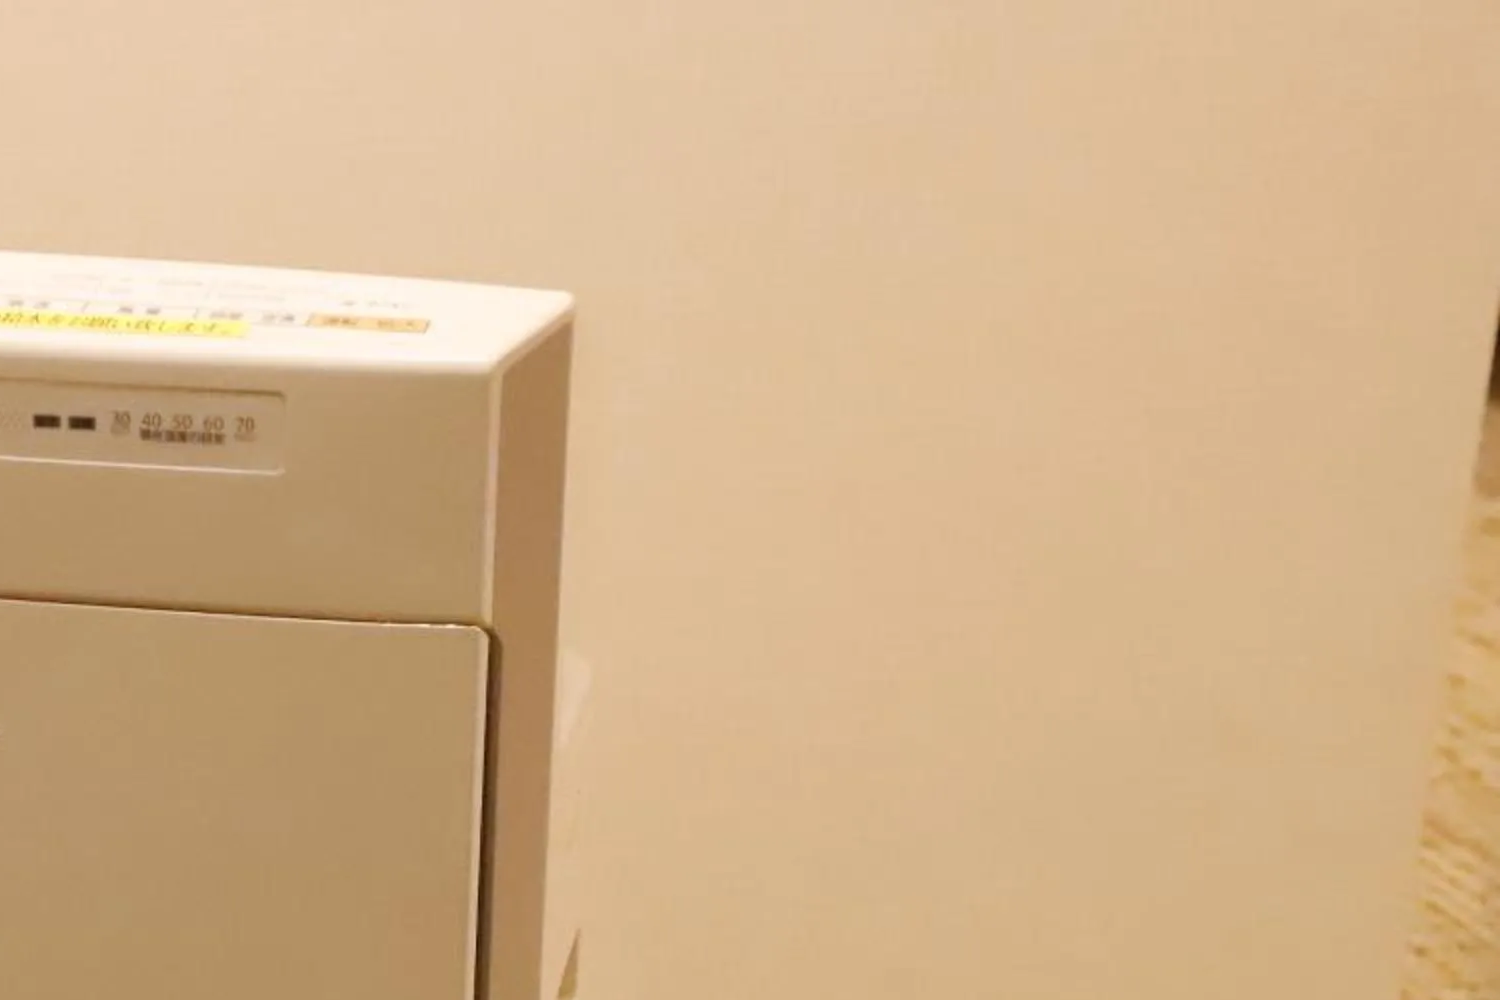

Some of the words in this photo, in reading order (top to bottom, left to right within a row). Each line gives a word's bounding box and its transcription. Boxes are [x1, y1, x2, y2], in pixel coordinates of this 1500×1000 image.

[141, 412, 162, 429] 40
[172, 414, 193, 430] 50
[203, 416, 225, 431] 60
[236, 416, 255, 432] 70
